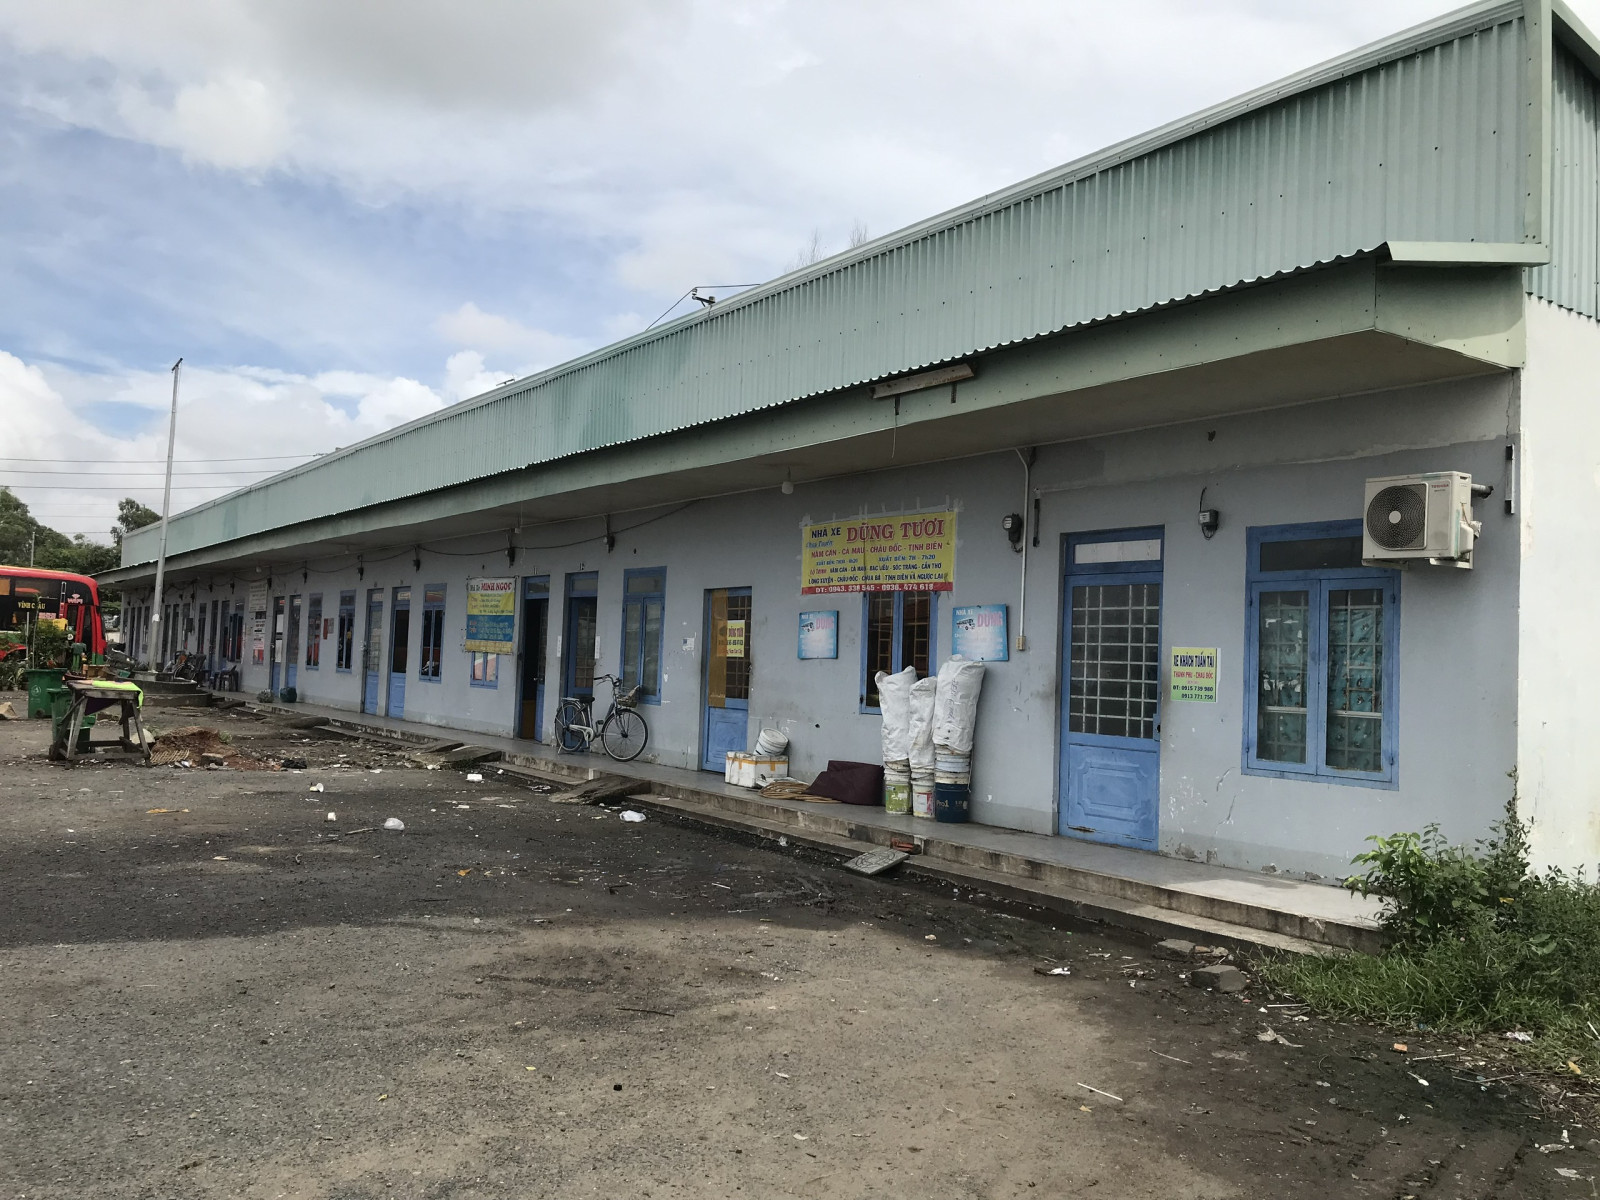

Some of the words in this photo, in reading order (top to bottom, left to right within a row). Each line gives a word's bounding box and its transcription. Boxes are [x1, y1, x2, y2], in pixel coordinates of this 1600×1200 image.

[812, 526, 828, 538] NHÀ
[831, 527, 841, 536] XE
[847, 521, 894, 543] DŨNG
[900, 518, 945, 539] TƯƠI
[852, 546, 865, 554] MAU
[908, 543, 924, 552] TỊNH
